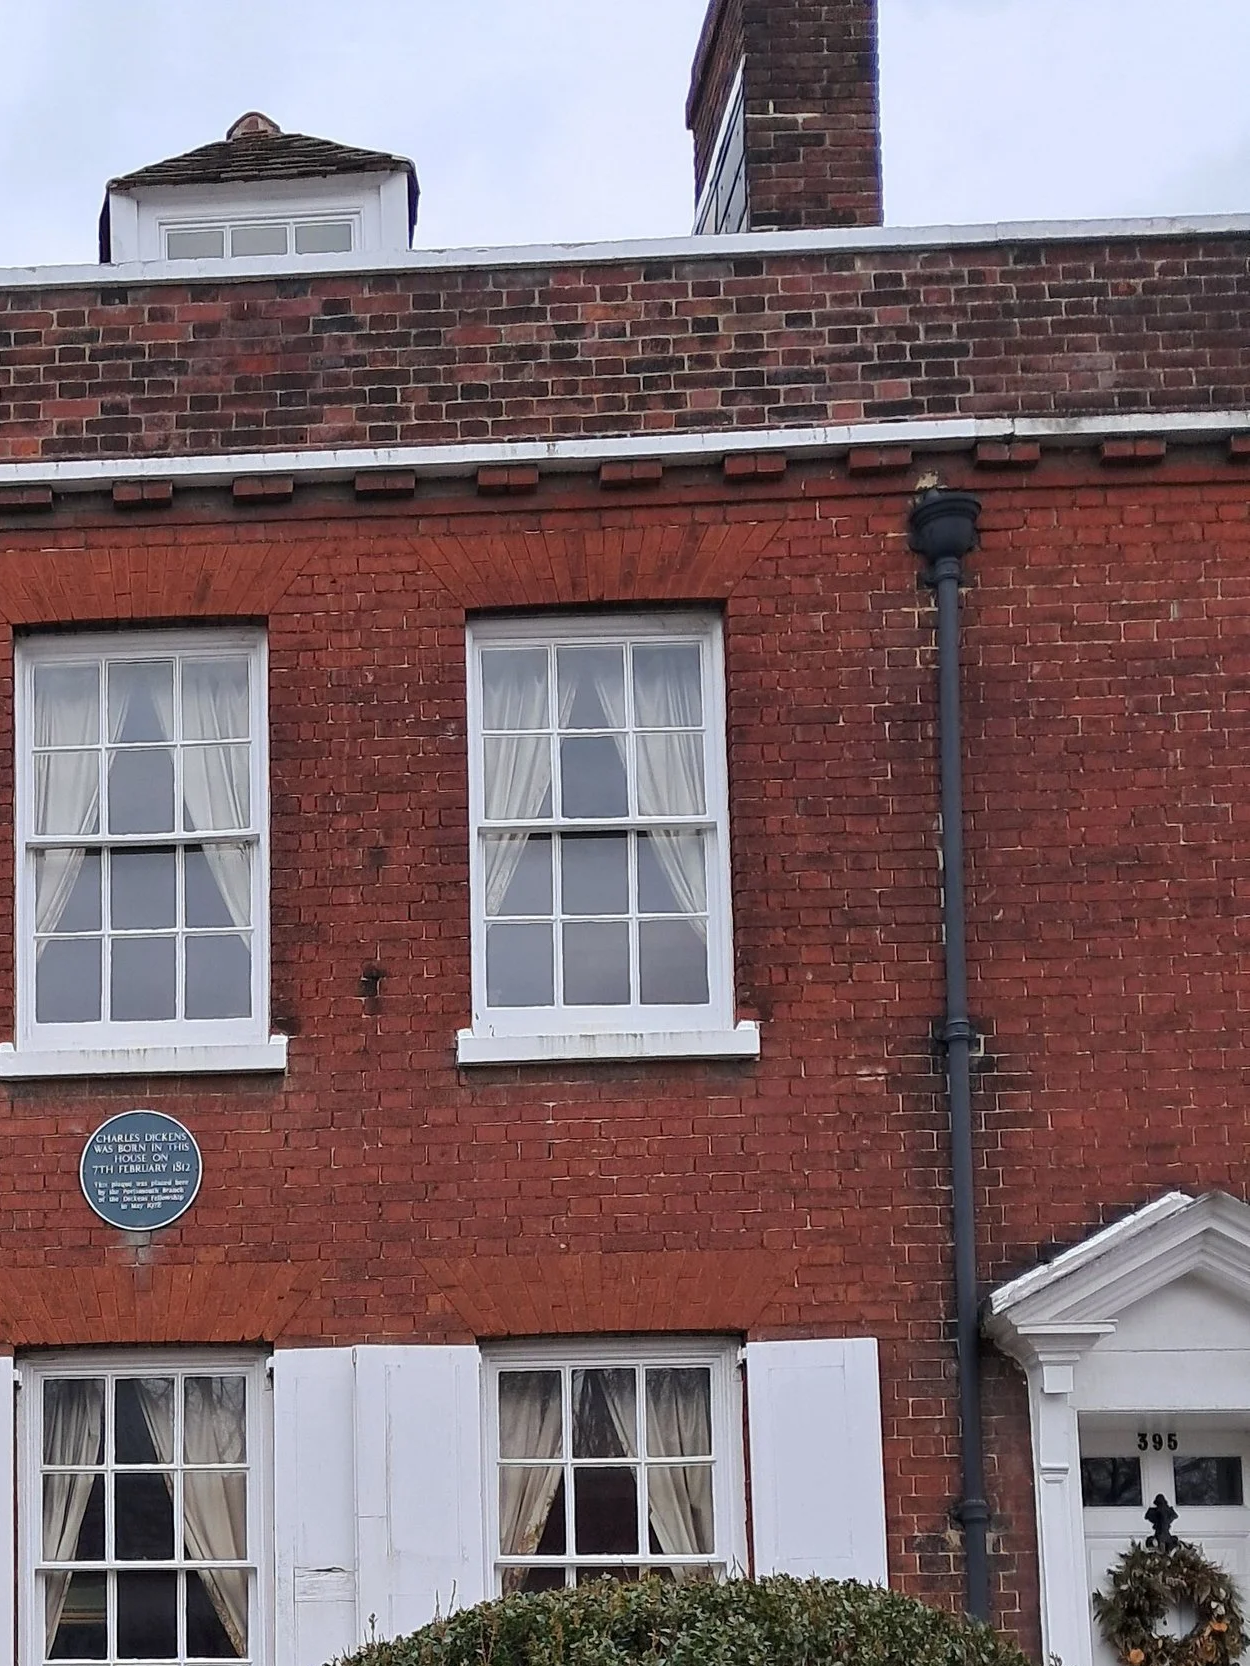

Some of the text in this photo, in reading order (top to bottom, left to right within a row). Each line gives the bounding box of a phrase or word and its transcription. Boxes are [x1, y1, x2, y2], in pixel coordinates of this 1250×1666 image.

[95, 1132, 187, 1143] CHARLES DICKENS
[93, 1142, 190, 1154] WAS BORN IN THIS
[114, 1153, 169, 1163] HOUSE ON
[92, 1161, 190, 1175] 7TH FEBRUARY 1812
[1137, 1433, 1178, 1451] 395
